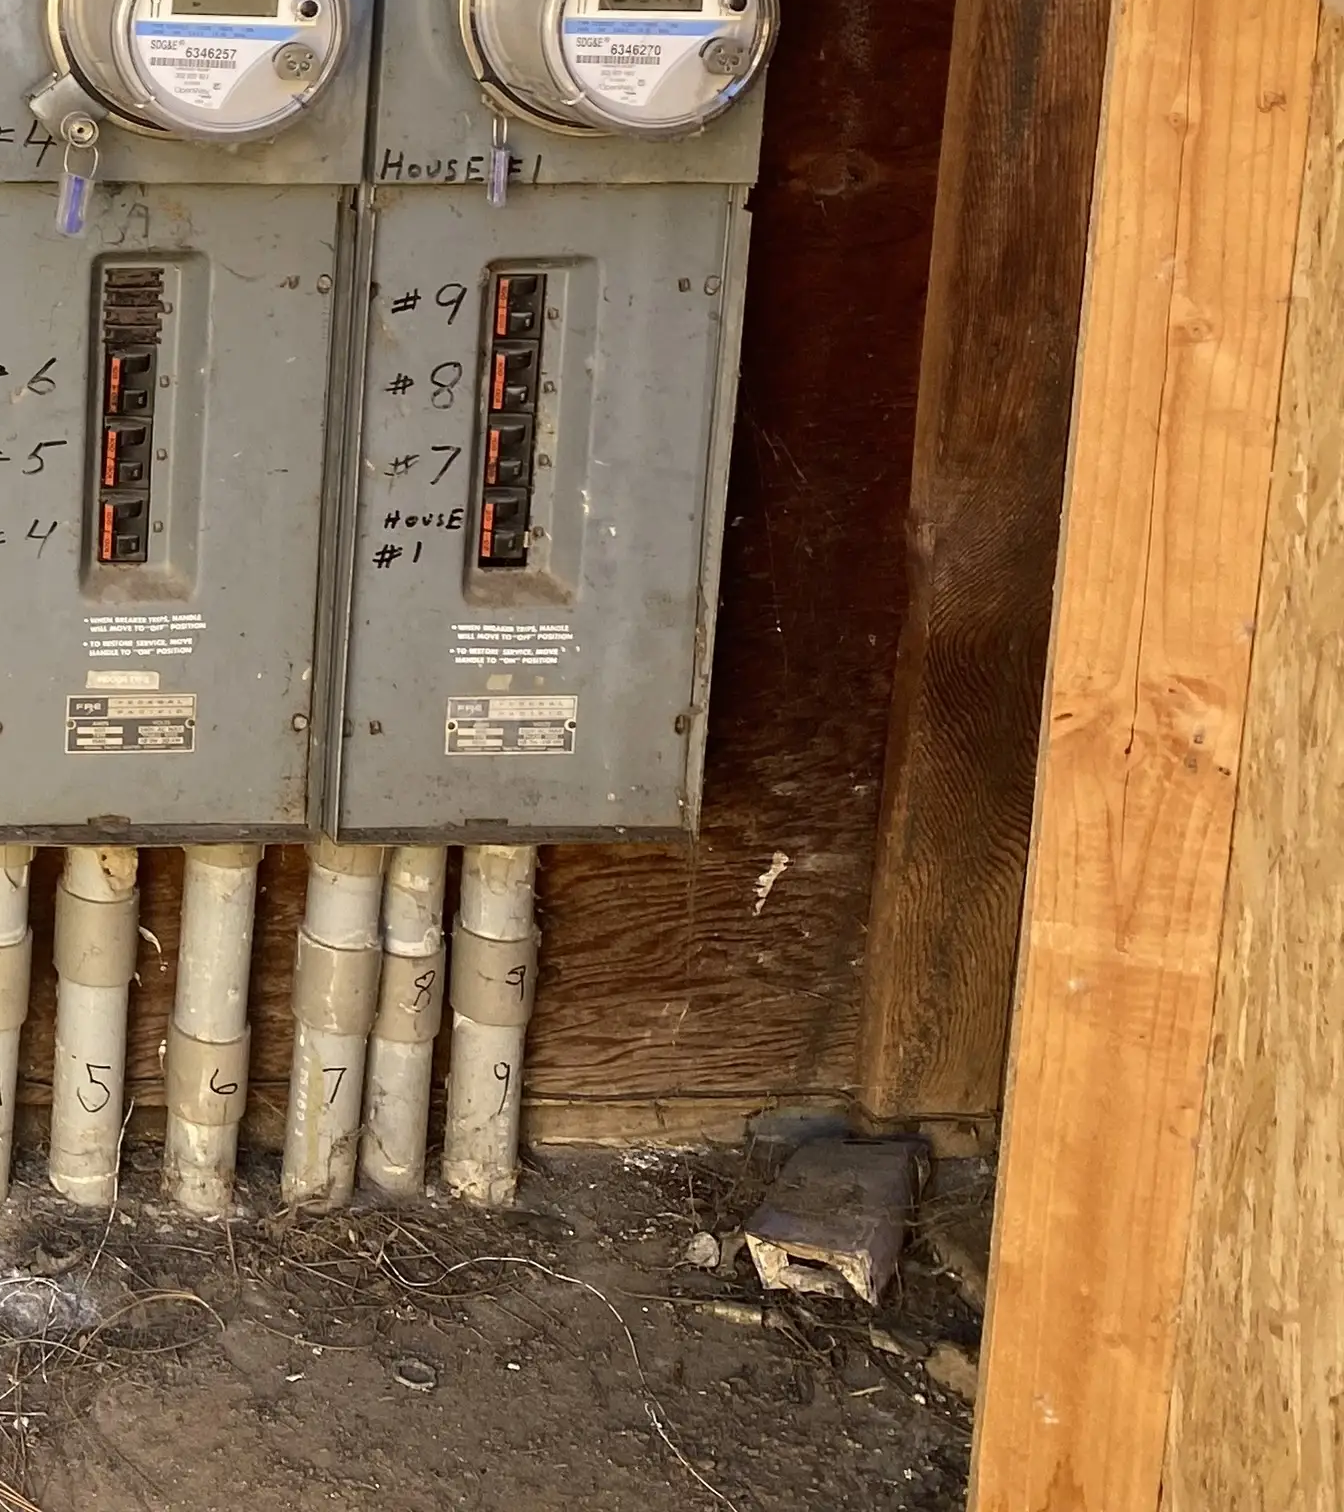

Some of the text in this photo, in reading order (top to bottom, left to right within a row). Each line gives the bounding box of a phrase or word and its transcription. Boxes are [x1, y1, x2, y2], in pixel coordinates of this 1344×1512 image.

[185, 48, 237, 60] 6346257
[610, 44, 662, 56] 6346270
[380, 148, 486, 182] HOUSE
[391, 282, 468, 326] #9
[383, 361, 464, 410] #8
[383, 445, 463, 486] #7
[382, 507, 466, 531] HOUSE
[372, 542, 424, 569] #1
[75, 1062, 112, 1113] 5
[208, 1067, 239, 1096] 6
[322, 1066, 347, 1105] 7
[492, 1061, 511, 1116] 9
